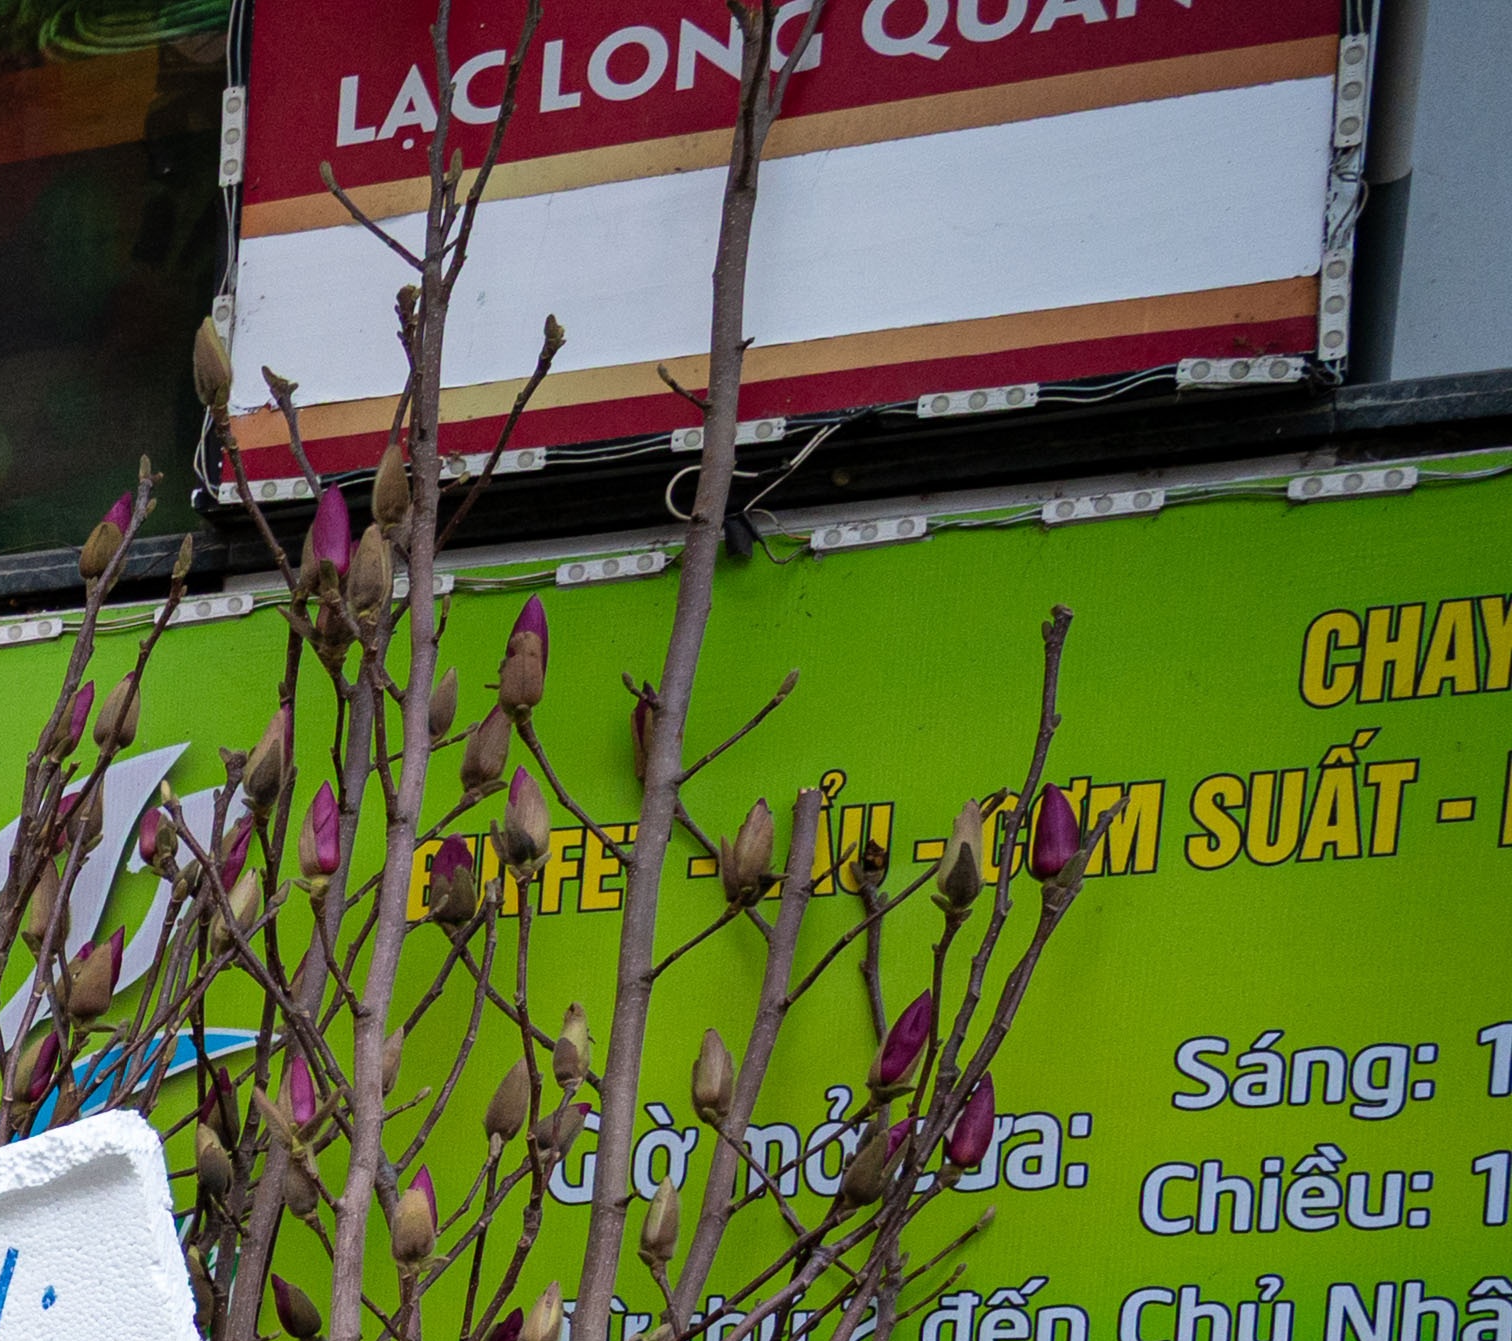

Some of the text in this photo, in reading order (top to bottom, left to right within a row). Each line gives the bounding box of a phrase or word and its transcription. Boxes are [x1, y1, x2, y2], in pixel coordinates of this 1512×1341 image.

[335, 48, 507, 151] LẠC
[538, 1, 824, 114] LONG
[1183, 727, 1420, 872] SUẤT
[1171, 1030, 1438, 1121] Sáng:
[1139, 1143, 1434, 1237] Chiều:
